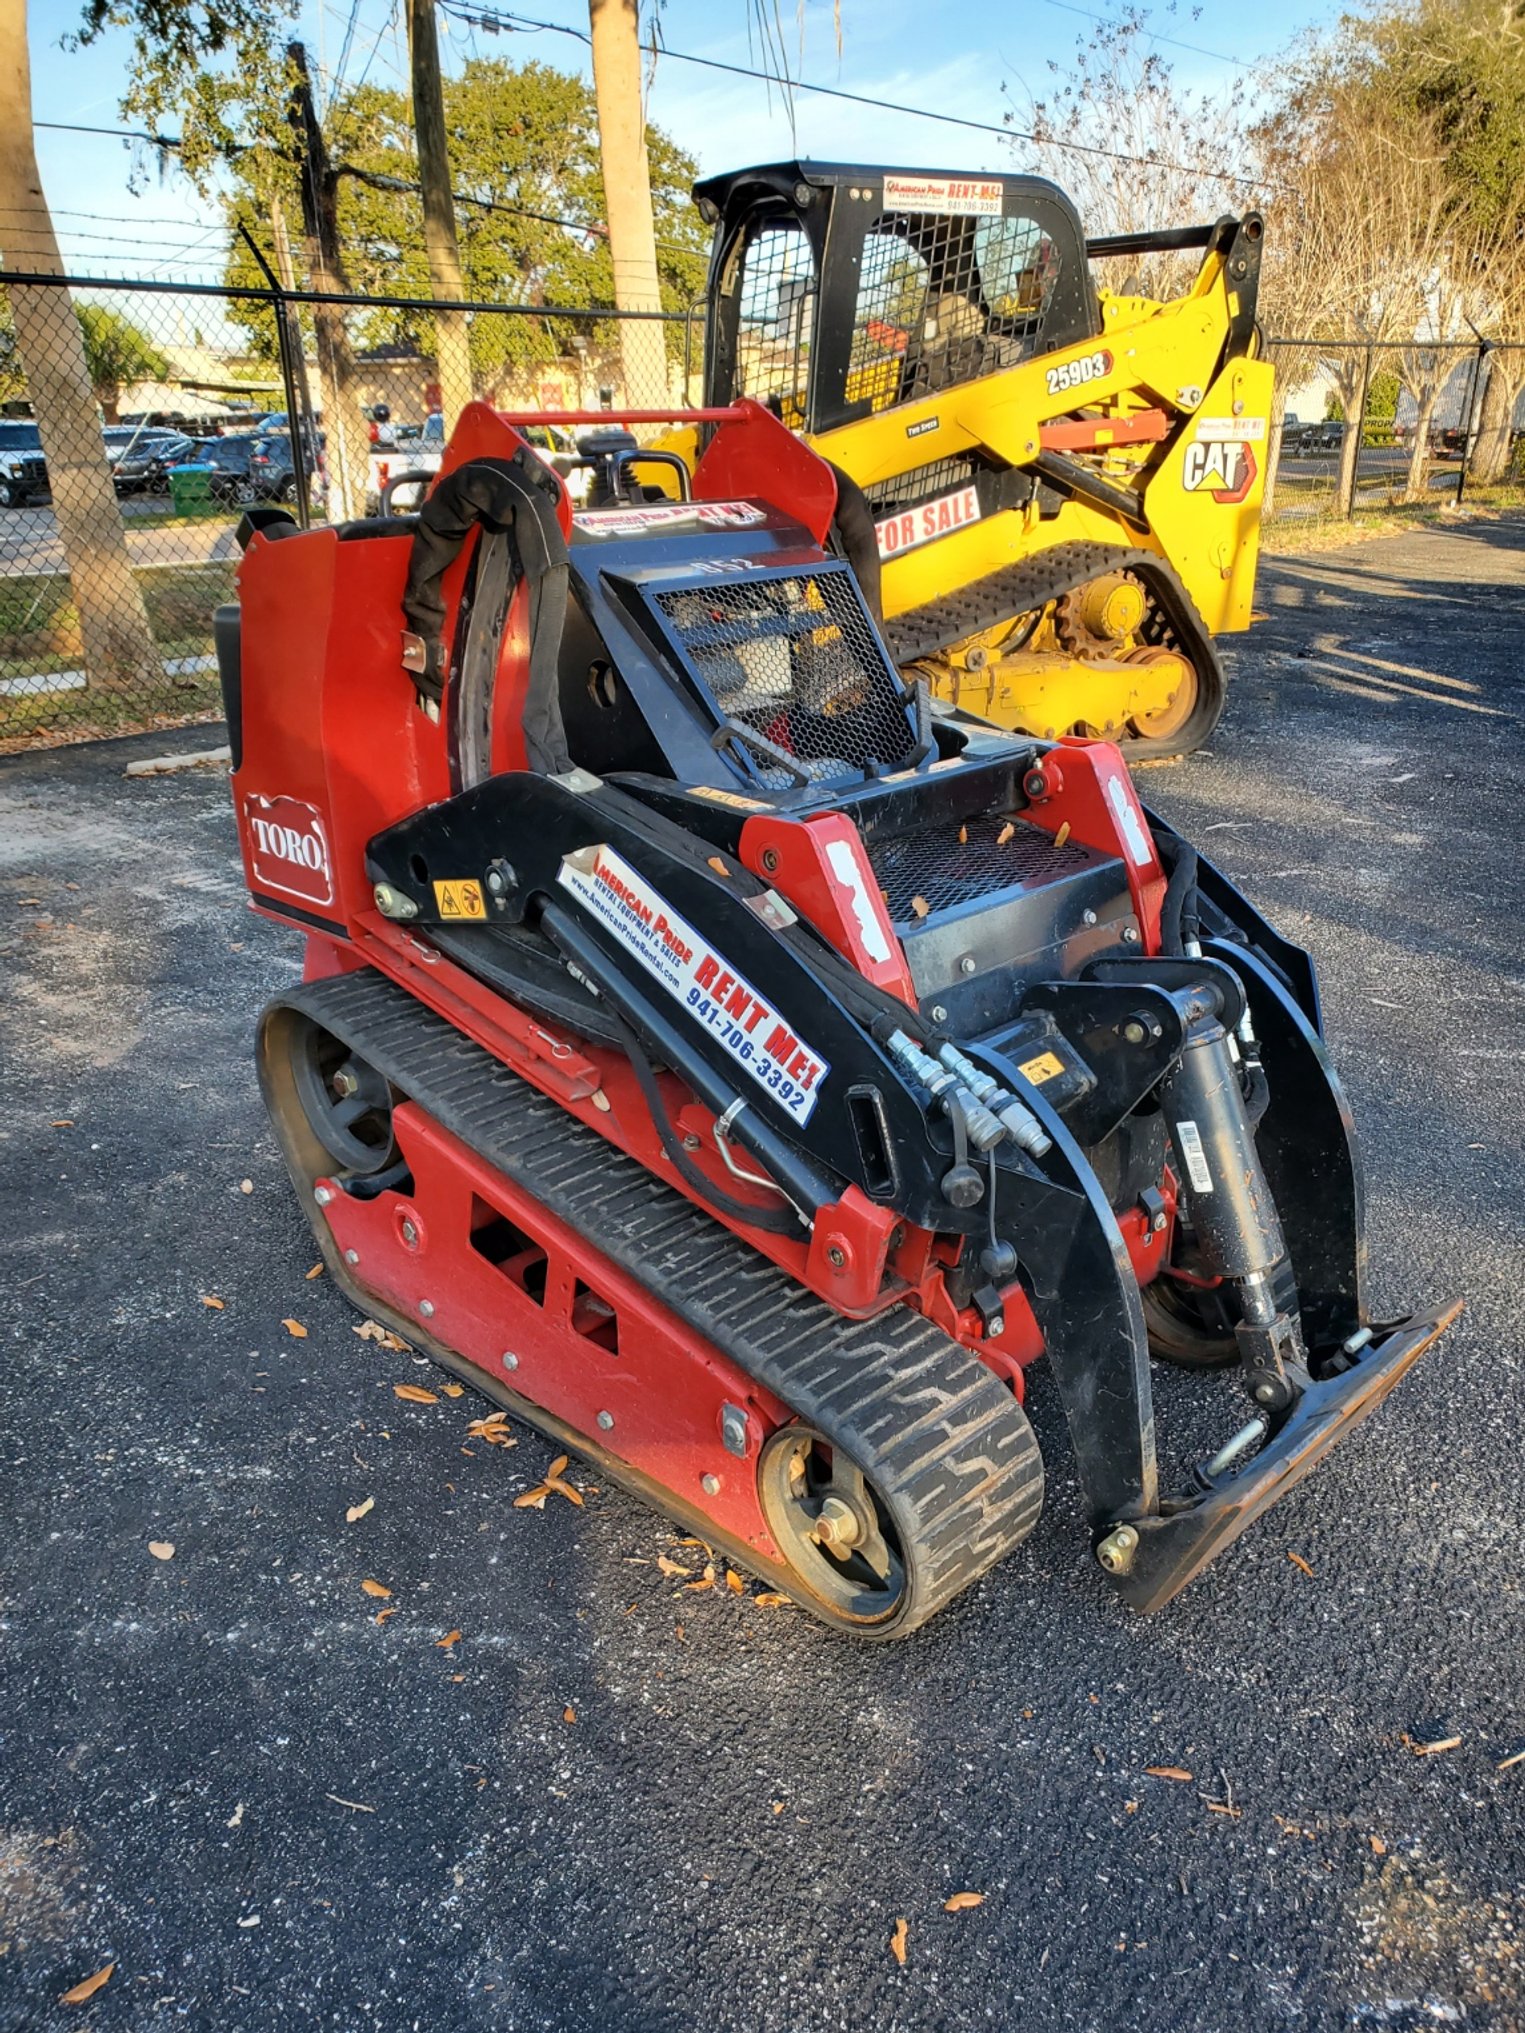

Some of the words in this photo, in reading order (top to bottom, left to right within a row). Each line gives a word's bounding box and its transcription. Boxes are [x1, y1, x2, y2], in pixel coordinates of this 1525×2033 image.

[947, 183, 977, 199] RENT
[1046, 352, 1105, 395] 259D3
[1184, 442, 1243, 491] CAT
[922, 491, 975, 537] SALE
[251, 817, 322, 871] TORO
[571, 875, 680, 988] www.AmericanPrideRental.com
[593, 877, 617, 902] RENTAL
[616, 900, 654, 941] EQUIPMENT
[653, 938, 660, 948] &
[660, 943, 682, 968] SALES
[653, 913, 693, 966] PRIDE
[694, 953, 769, 1034] RENT
[763, 1023, 821, 1091] ME!
[686, 987, 806, 1112] 941-706-3392
